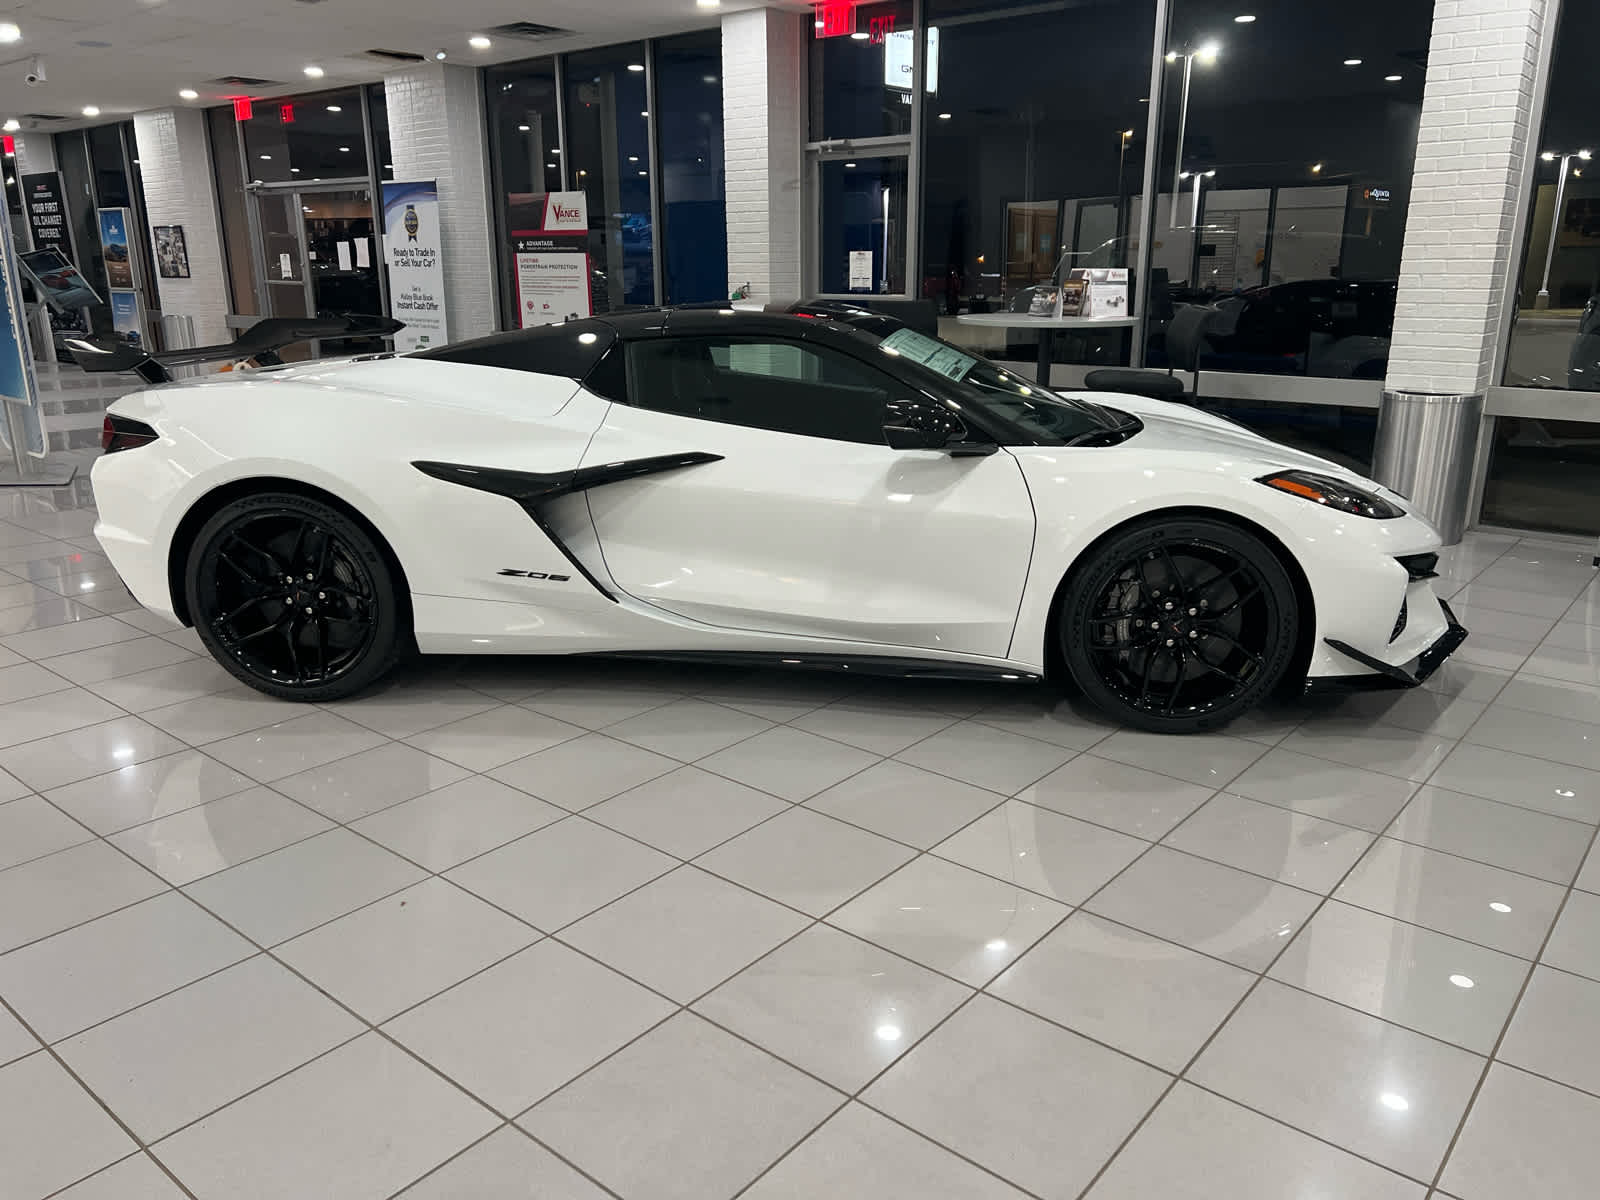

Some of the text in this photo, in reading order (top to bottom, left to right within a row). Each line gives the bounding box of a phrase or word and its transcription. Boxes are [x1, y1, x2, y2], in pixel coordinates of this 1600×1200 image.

[870, 16, 896, 44] EXIT
[32, 202, 58, 213] YOUR FIRST
[553, 204, 580, 222] VANCE
[393, 248, 408, 258] Ready
[414, 248, 429, 257] Trade
[430, 248, 435, 257] In
[401, 259, 410, 267] Sell
[411, 259, 422, 267] Your
[423, 259, 436, 268] Car?
[397, 301, 413, 310] Instant
[413, 302, 425, 310] Cash
[496, 568, 571, 582] Z06
